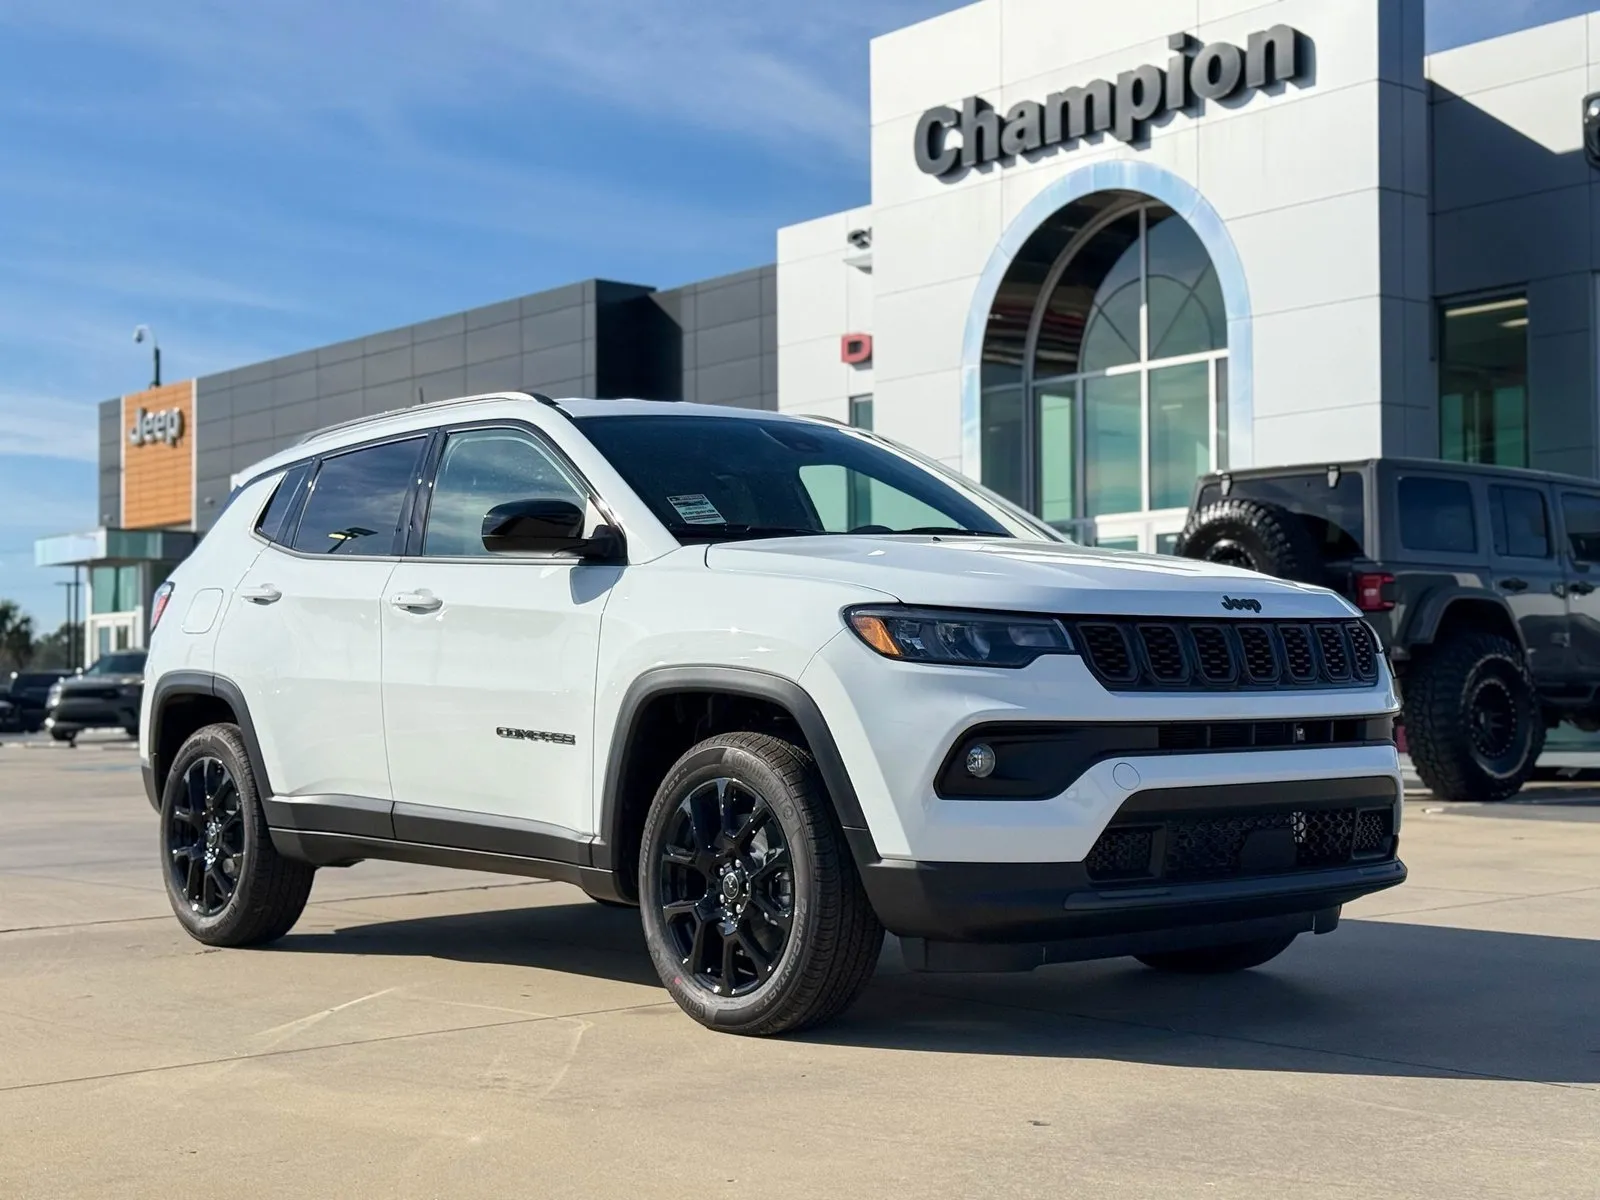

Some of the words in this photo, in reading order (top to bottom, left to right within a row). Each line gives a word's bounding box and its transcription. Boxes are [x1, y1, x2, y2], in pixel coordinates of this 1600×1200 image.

[913, 23, 1304, 178] Champion
[129, 407, 184, 446] Jeep
[1221, 595, 1262, 613] Jeep
[496, 726, 576, 745] COMPASS
